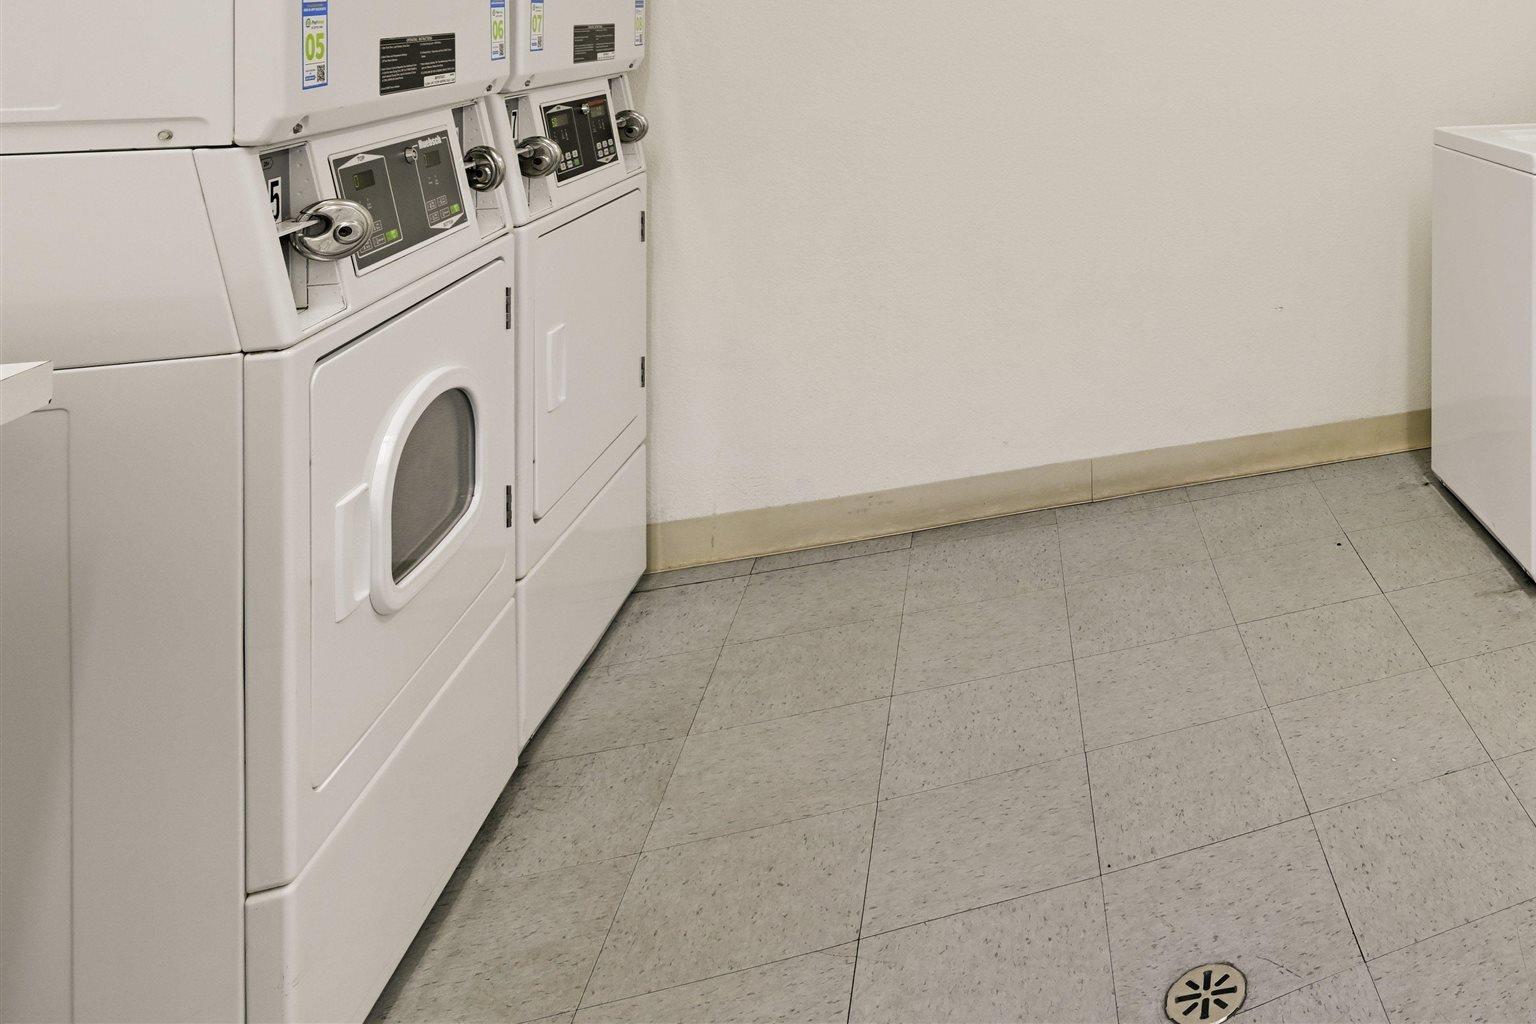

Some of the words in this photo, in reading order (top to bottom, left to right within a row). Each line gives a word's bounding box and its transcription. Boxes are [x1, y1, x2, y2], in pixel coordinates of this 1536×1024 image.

[492, 19, 504, 40] 06
[531, 15, 543, 33] 07
[305, 32, 325, 61] 05
